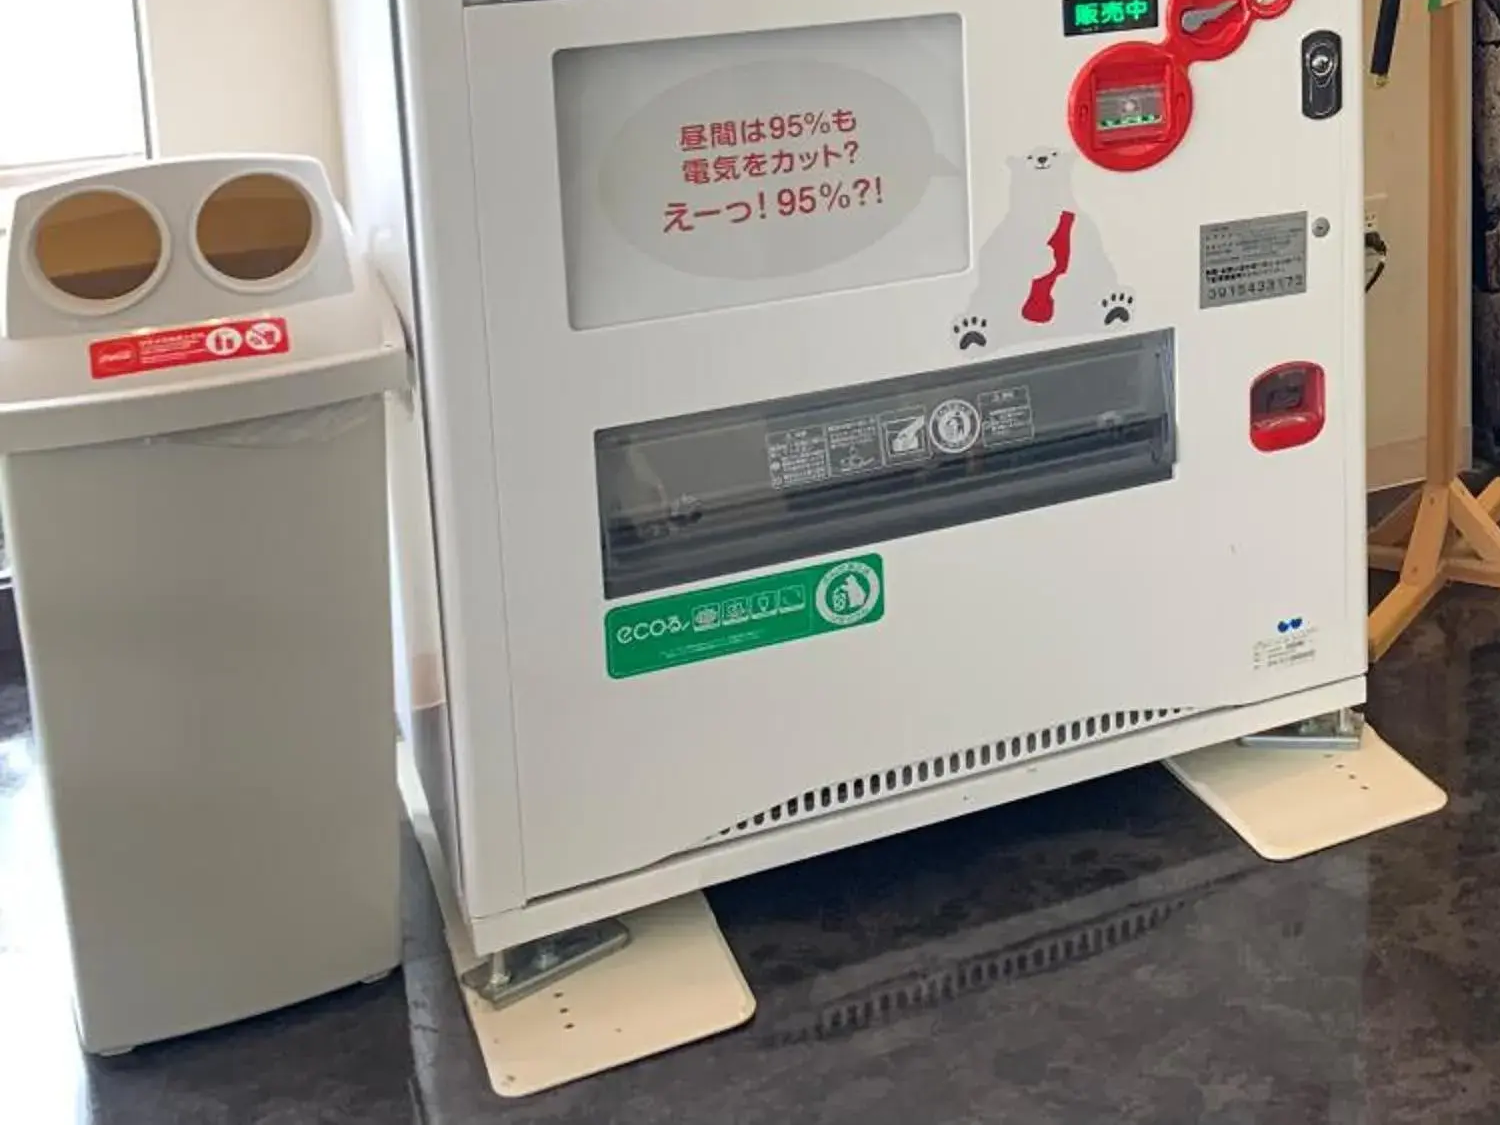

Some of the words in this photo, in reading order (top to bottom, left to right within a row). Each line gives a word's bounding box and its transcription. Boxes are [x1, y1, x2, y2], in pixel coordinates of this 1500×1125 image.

[679, 108, 858, 153] 昼間は95%も
[681, 139, 860, 186] 電気をカット?
